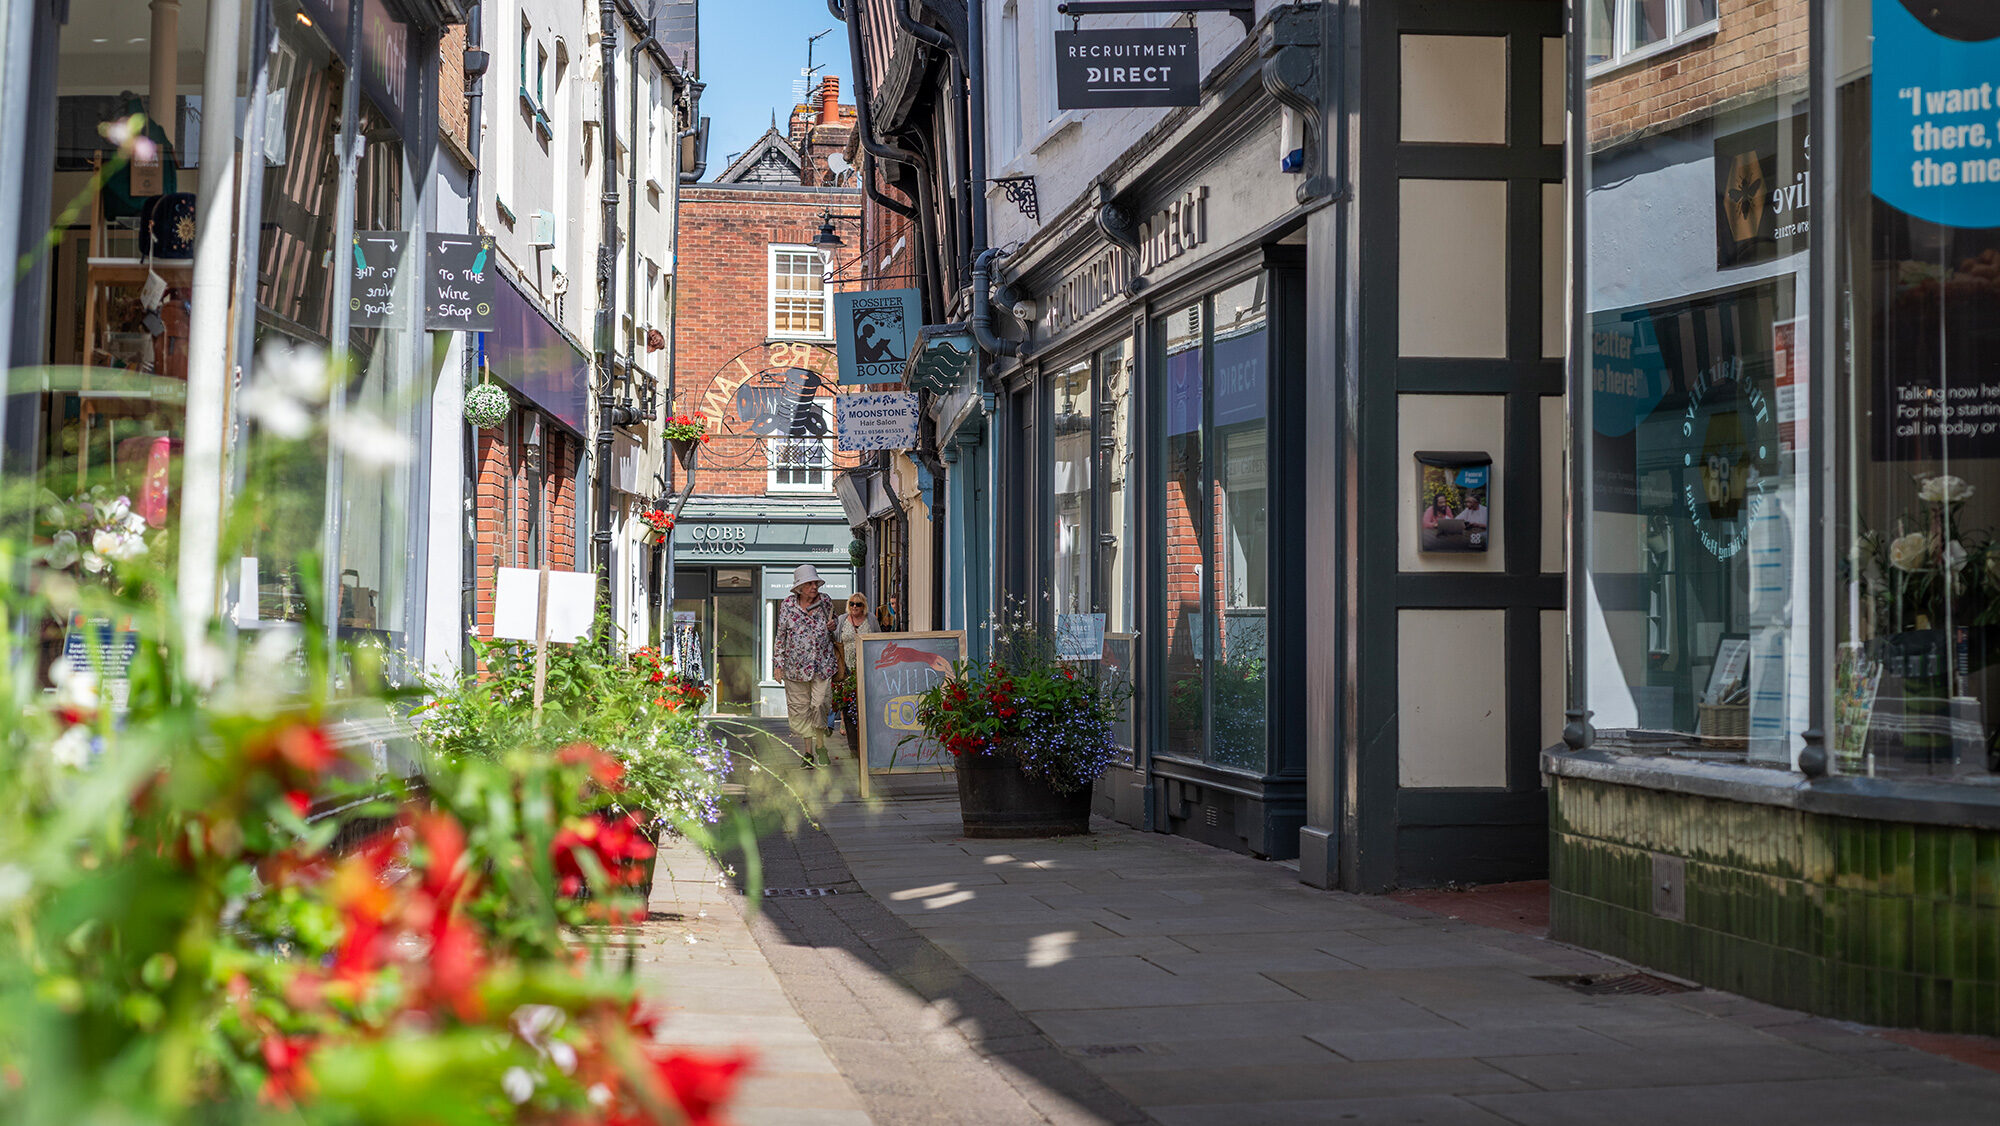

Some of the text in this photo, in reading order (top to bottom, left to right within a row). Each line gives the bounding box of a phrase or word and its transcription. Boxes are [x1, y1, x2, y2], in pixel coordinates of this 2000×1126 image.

[1068, 44, 1187, 58] RECRUITMENT
[1086, 66, 1171, 82] DIRECT
[1926, 82, 1993, 115] want
[1911, 121, 1993, 152] there,
[1911, 157, 1958, 188] the
[1138, 184, 1209, 276] DIRECT
[438, 284, 471, 301] Wine
[852, 297, 903, 309] ROSSITER
[438, 303, 473, 322] Shop
[856, 363, 907, 378] BOOKS
[1219, 358, 1258, 397] DIRECT
[1896, 385, 1945, 403] Talking
[1948, 387, 1979, 399] now
[848, 408, 907, 419] MOONSTONE
[1897, 404, 1921, 418] For
[859, 418, 897, 427] Hair Salon
[1896, 420, 1999, 439] call in today or
[691, 526, 746, 540] COBB
[691, 541, 747, 555] AMOS
[731, 576, 740, 585] 2
[883, 667, 939, 695] WILD
